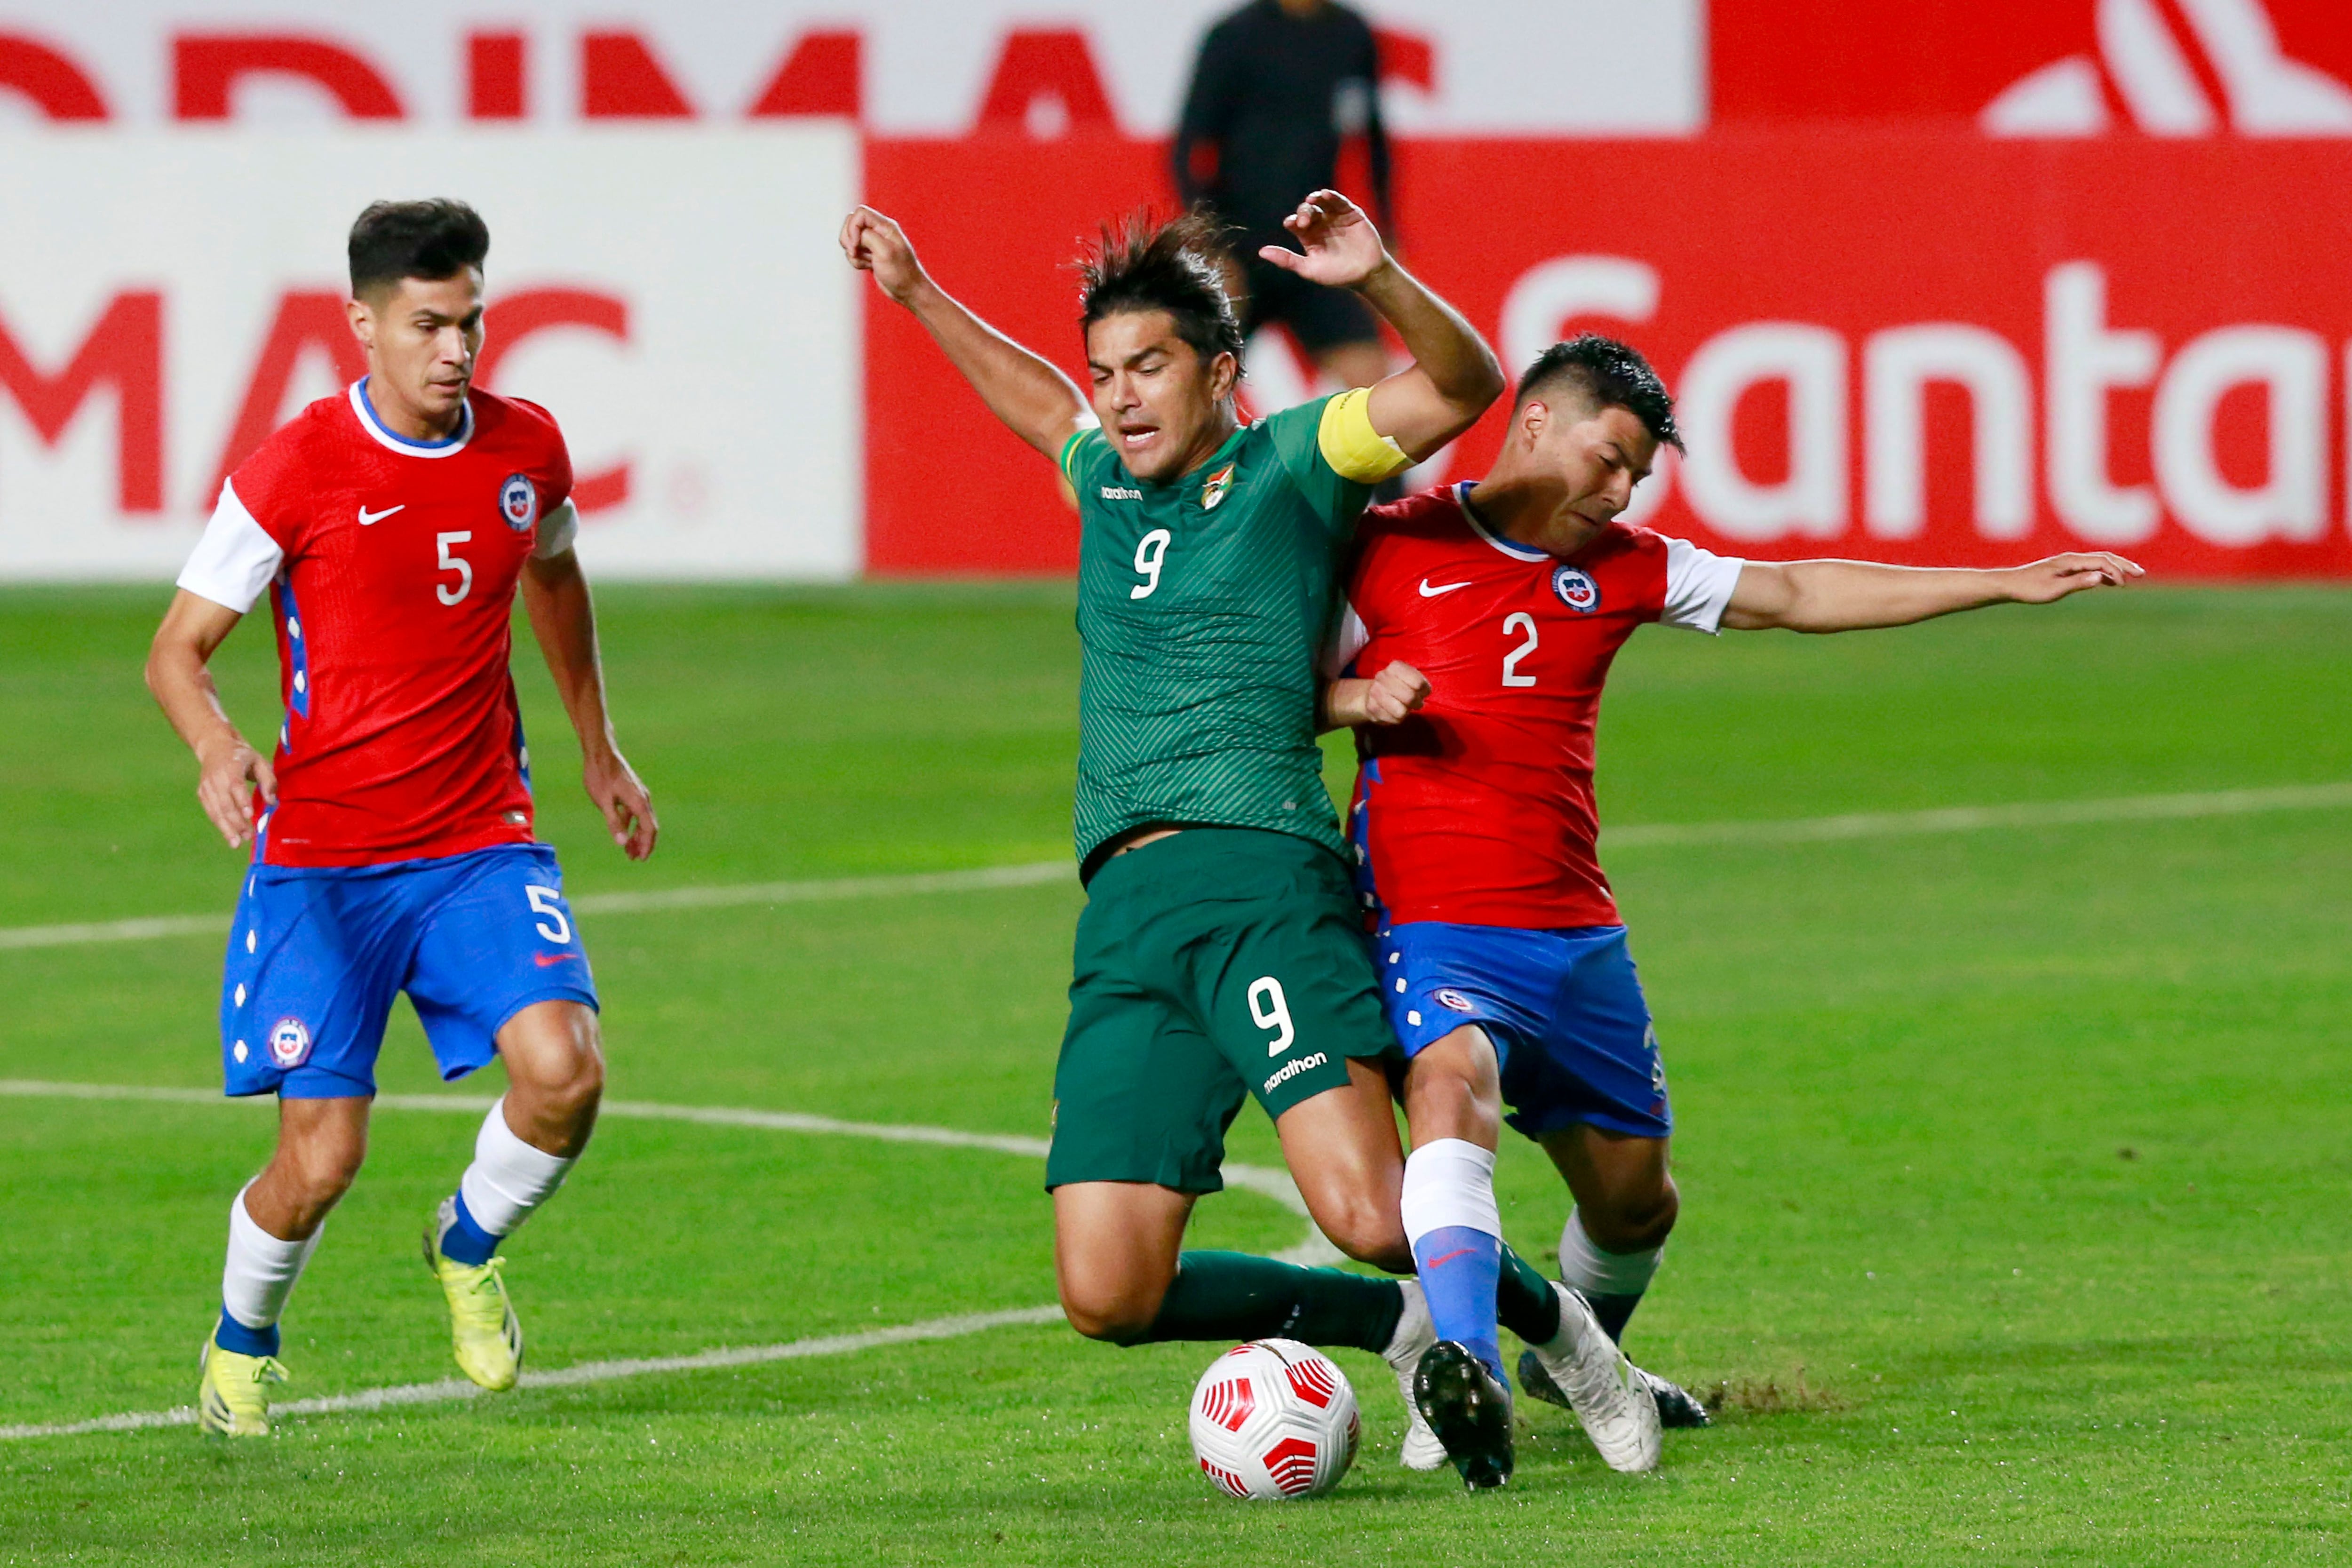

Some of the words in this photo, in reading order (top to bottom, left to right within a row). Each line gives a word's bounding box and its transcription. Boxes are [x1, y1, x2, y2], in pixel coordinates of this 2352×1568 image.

[1499, 255, 2352, 547] Santa
[437, 531, 472, 605] 5
[1130, 529, 1171, 599] 9
[1502, 612, 1538, 687] 2
[524, 885, 571, 944] 5
[1248, 976, 1295, 1058] 9
[1263, 1052, 1327, 1094] marathon
